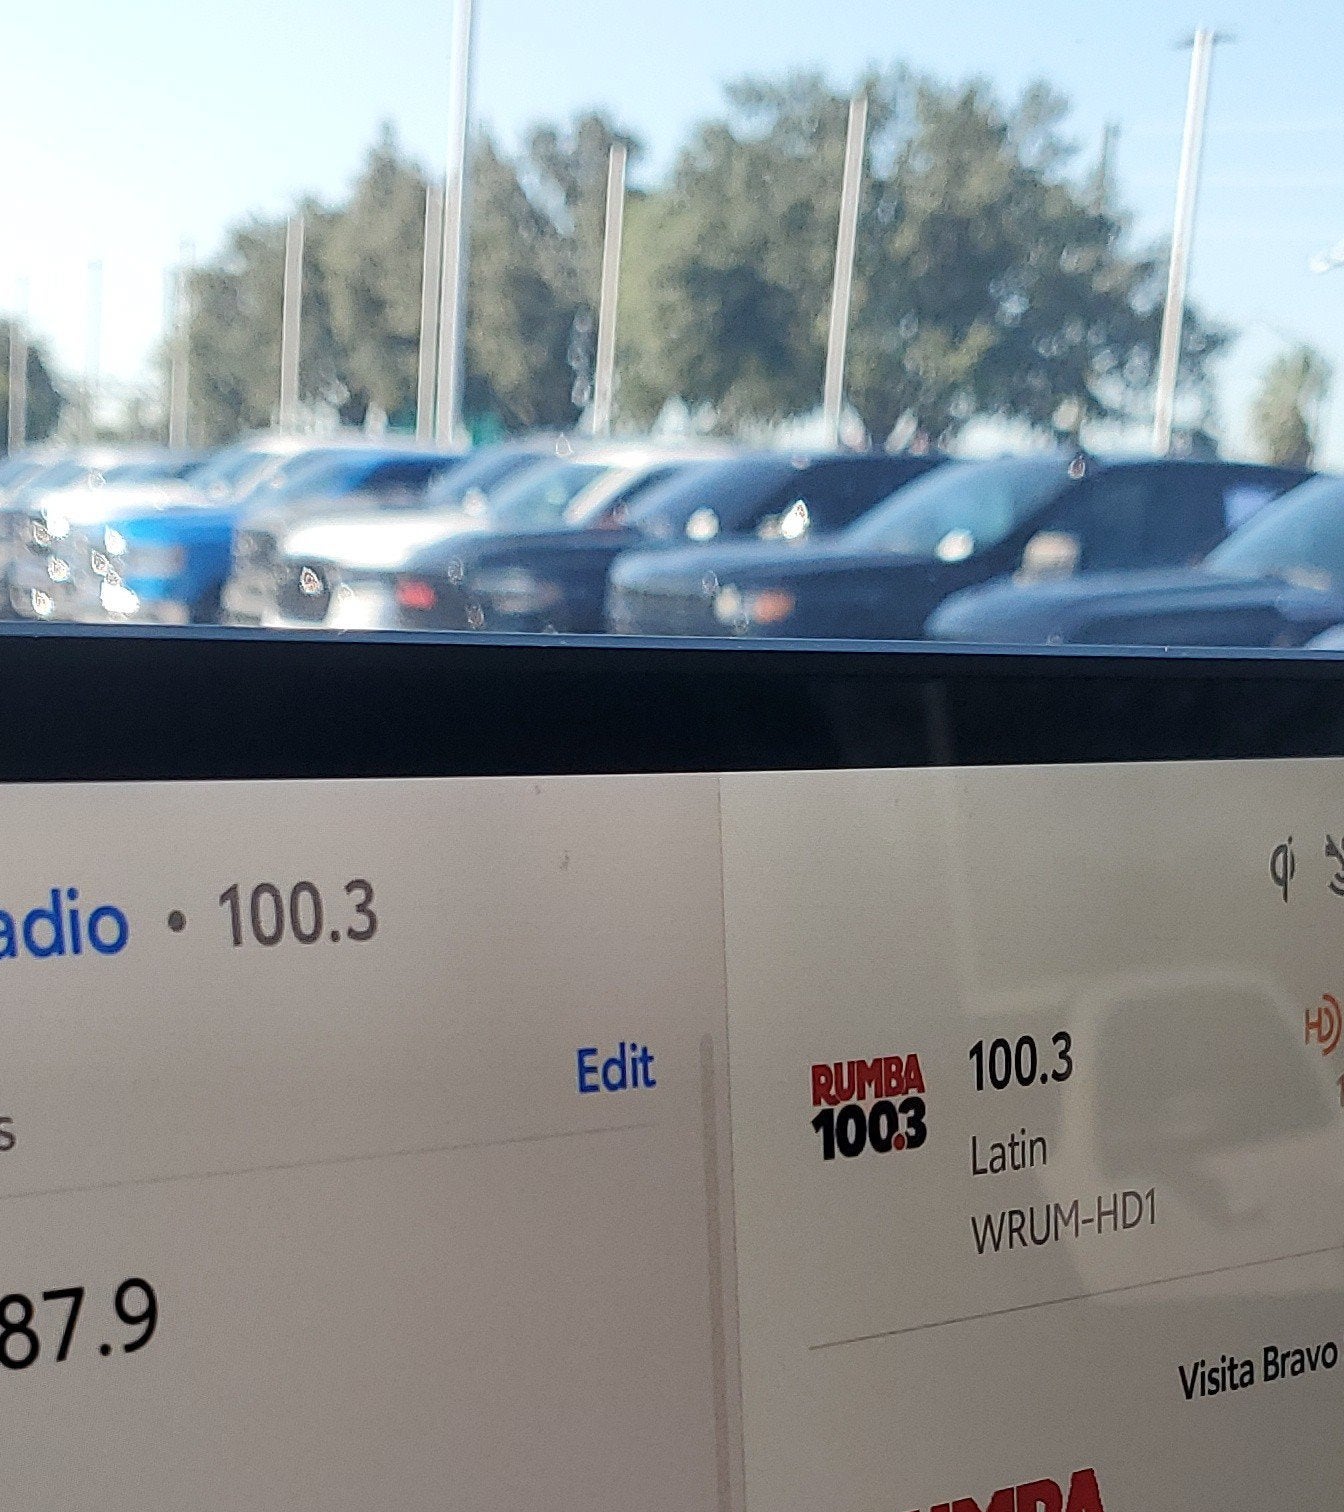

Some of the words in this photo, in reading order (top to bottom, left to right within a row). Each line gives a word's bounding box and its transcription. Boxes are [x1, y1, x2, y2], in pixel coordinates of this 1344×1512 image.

[219, 878, 378, 947] 100.3
[576, 1041, 657, 1094] Edit
[811, 1053, 926, 1107] RUMBA
[969, 1031, 1074, 1092] 100.3
[810, 1095, 928, 1161] 100.3
[971, 1127, 1048, 1176] Latin
[970, 1188, 1158, 1255] WRUM-HD1
[1178, 1357, 1255, 1401] Visita
[1263, 1341, 1338, 1383] Bravo
